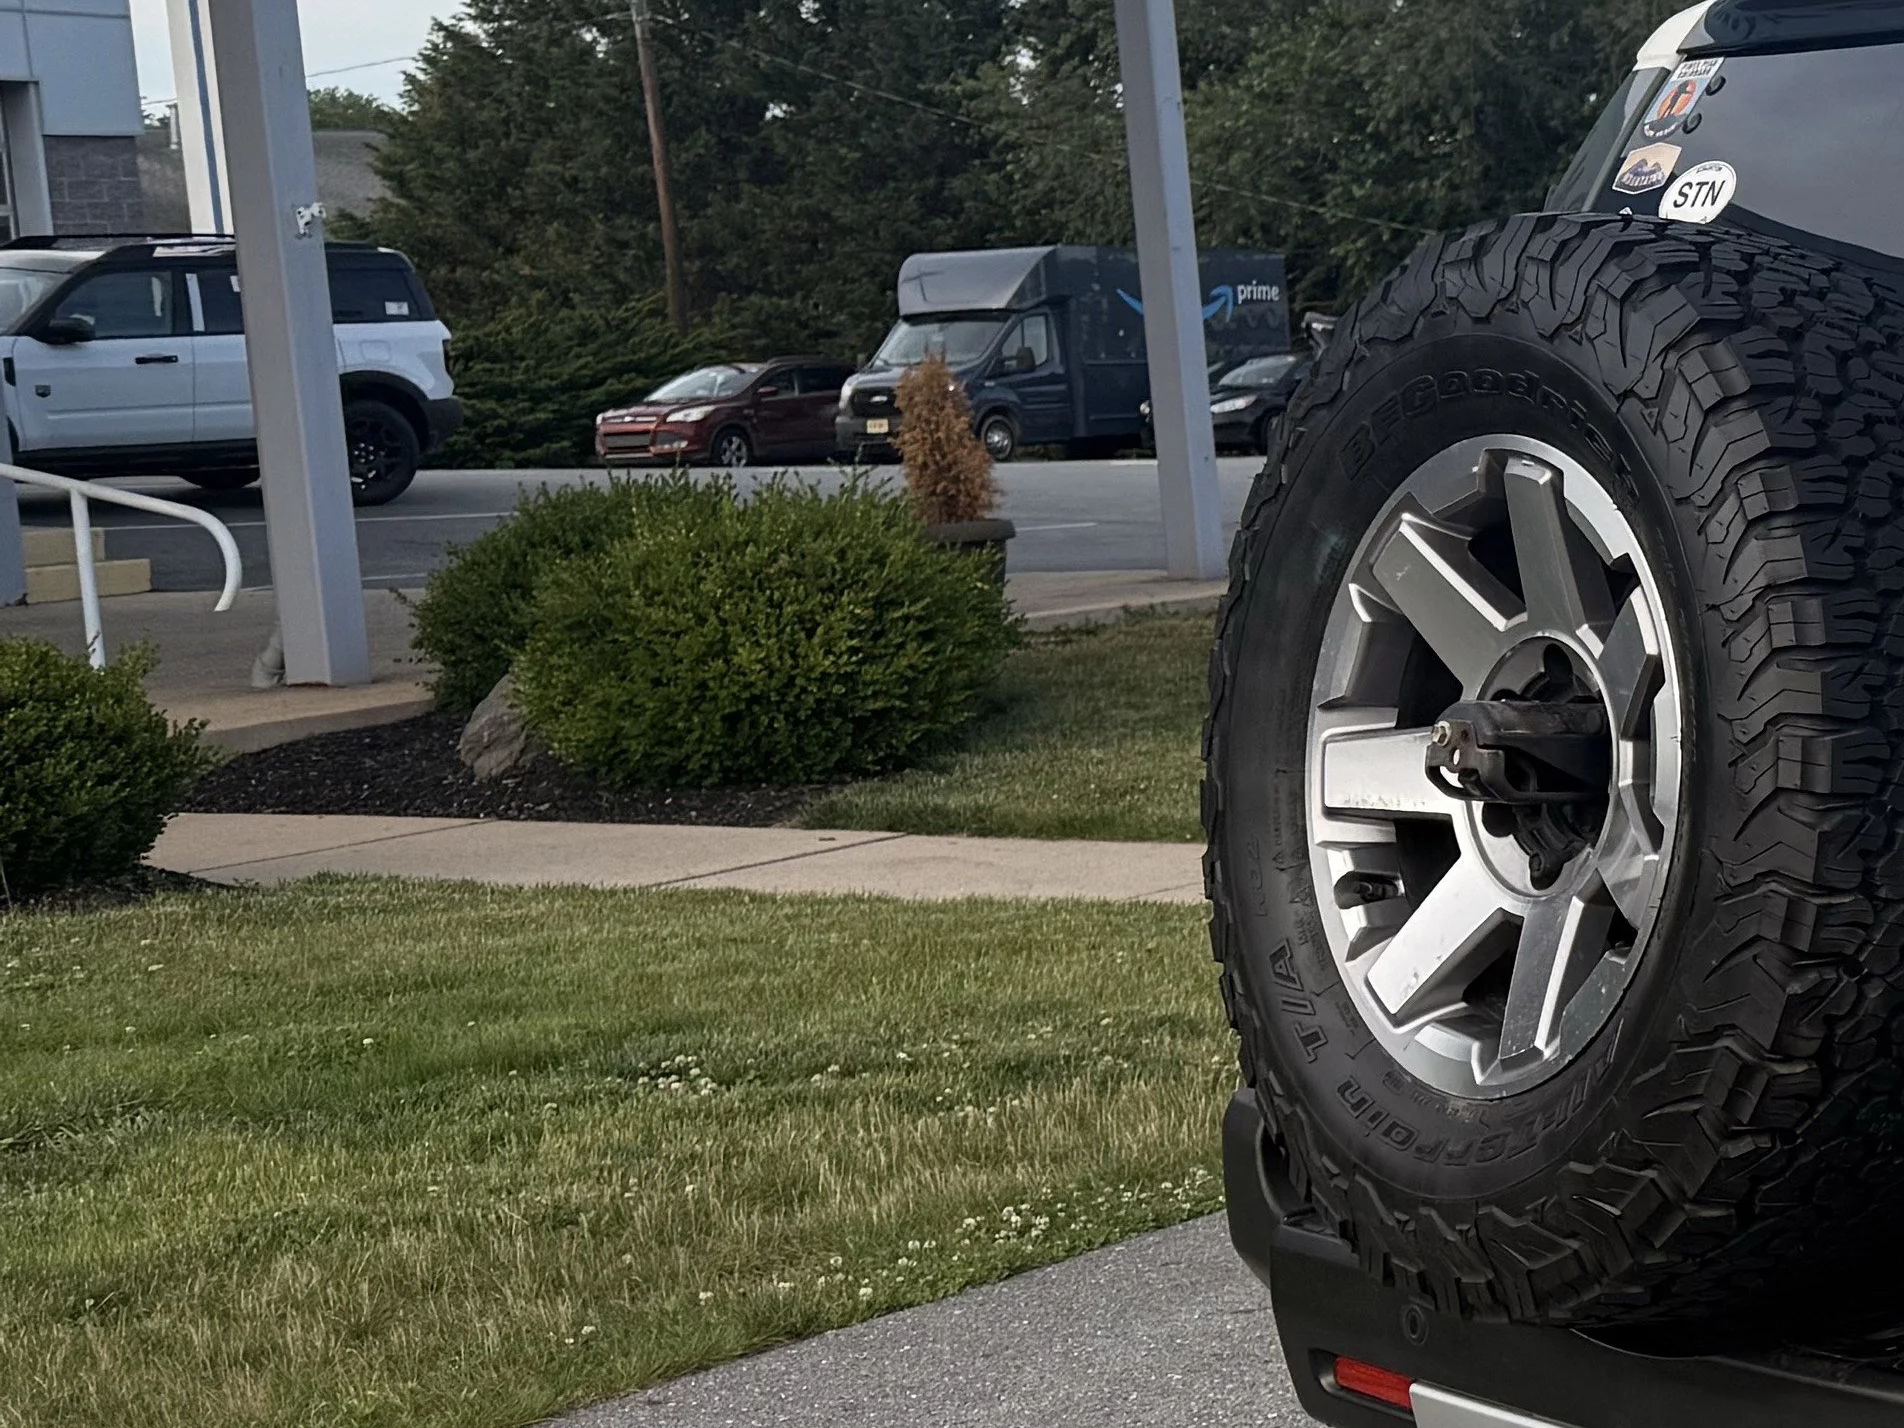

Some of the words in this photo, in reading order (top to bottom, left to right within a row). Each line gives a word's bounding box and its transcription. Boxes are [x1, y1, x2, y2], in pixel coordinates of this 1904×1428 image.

[1673, 180, 1727, 209] STN
[1237, 280, 1280, 305] prime
[1268, 936, 1329, 1065] T/A
